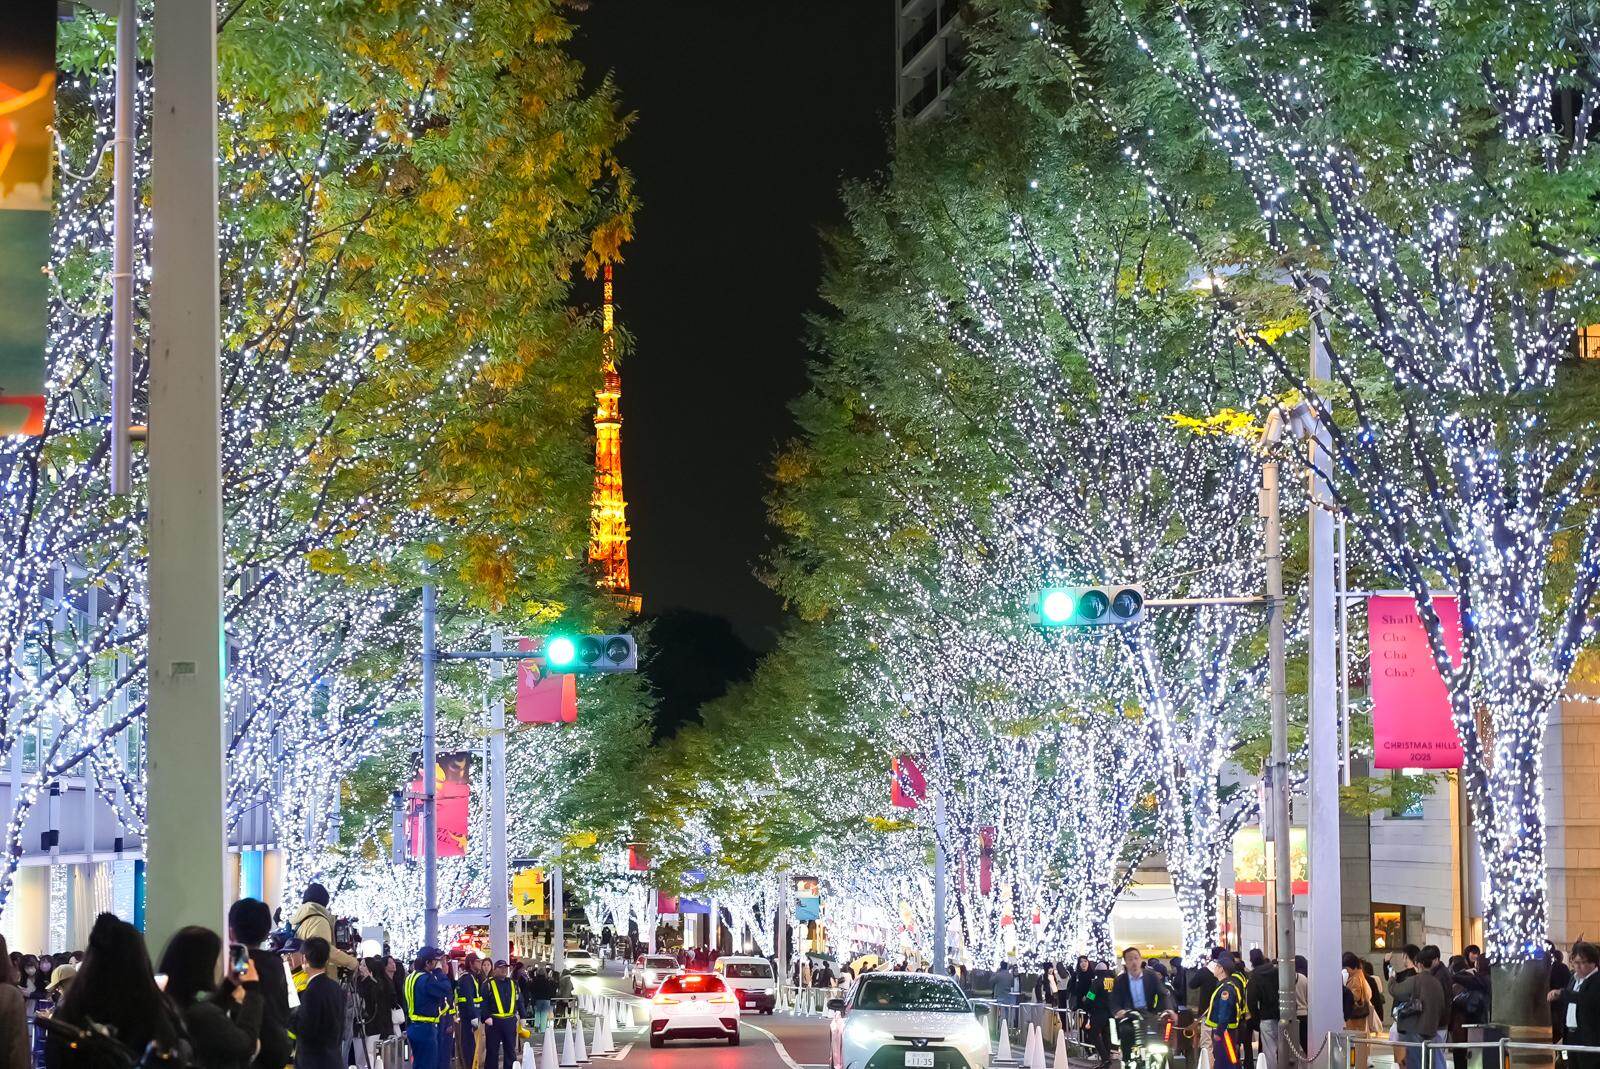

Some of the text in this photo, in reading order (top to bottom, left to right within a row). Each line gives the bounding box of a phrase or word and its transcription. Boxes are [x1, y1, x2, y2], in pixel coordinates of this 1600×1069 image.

[1382, 614, 1413, 624] Shall
[1382, 633, 1406, 642] Cha
[1383, 650, 1407, 659] Cha
[1384, 667, 1415, 677] Cha?
[1383, 741, 1457, 750] CHRISTMAS HILLS
[1410, 752, 1432, 761] 2025
